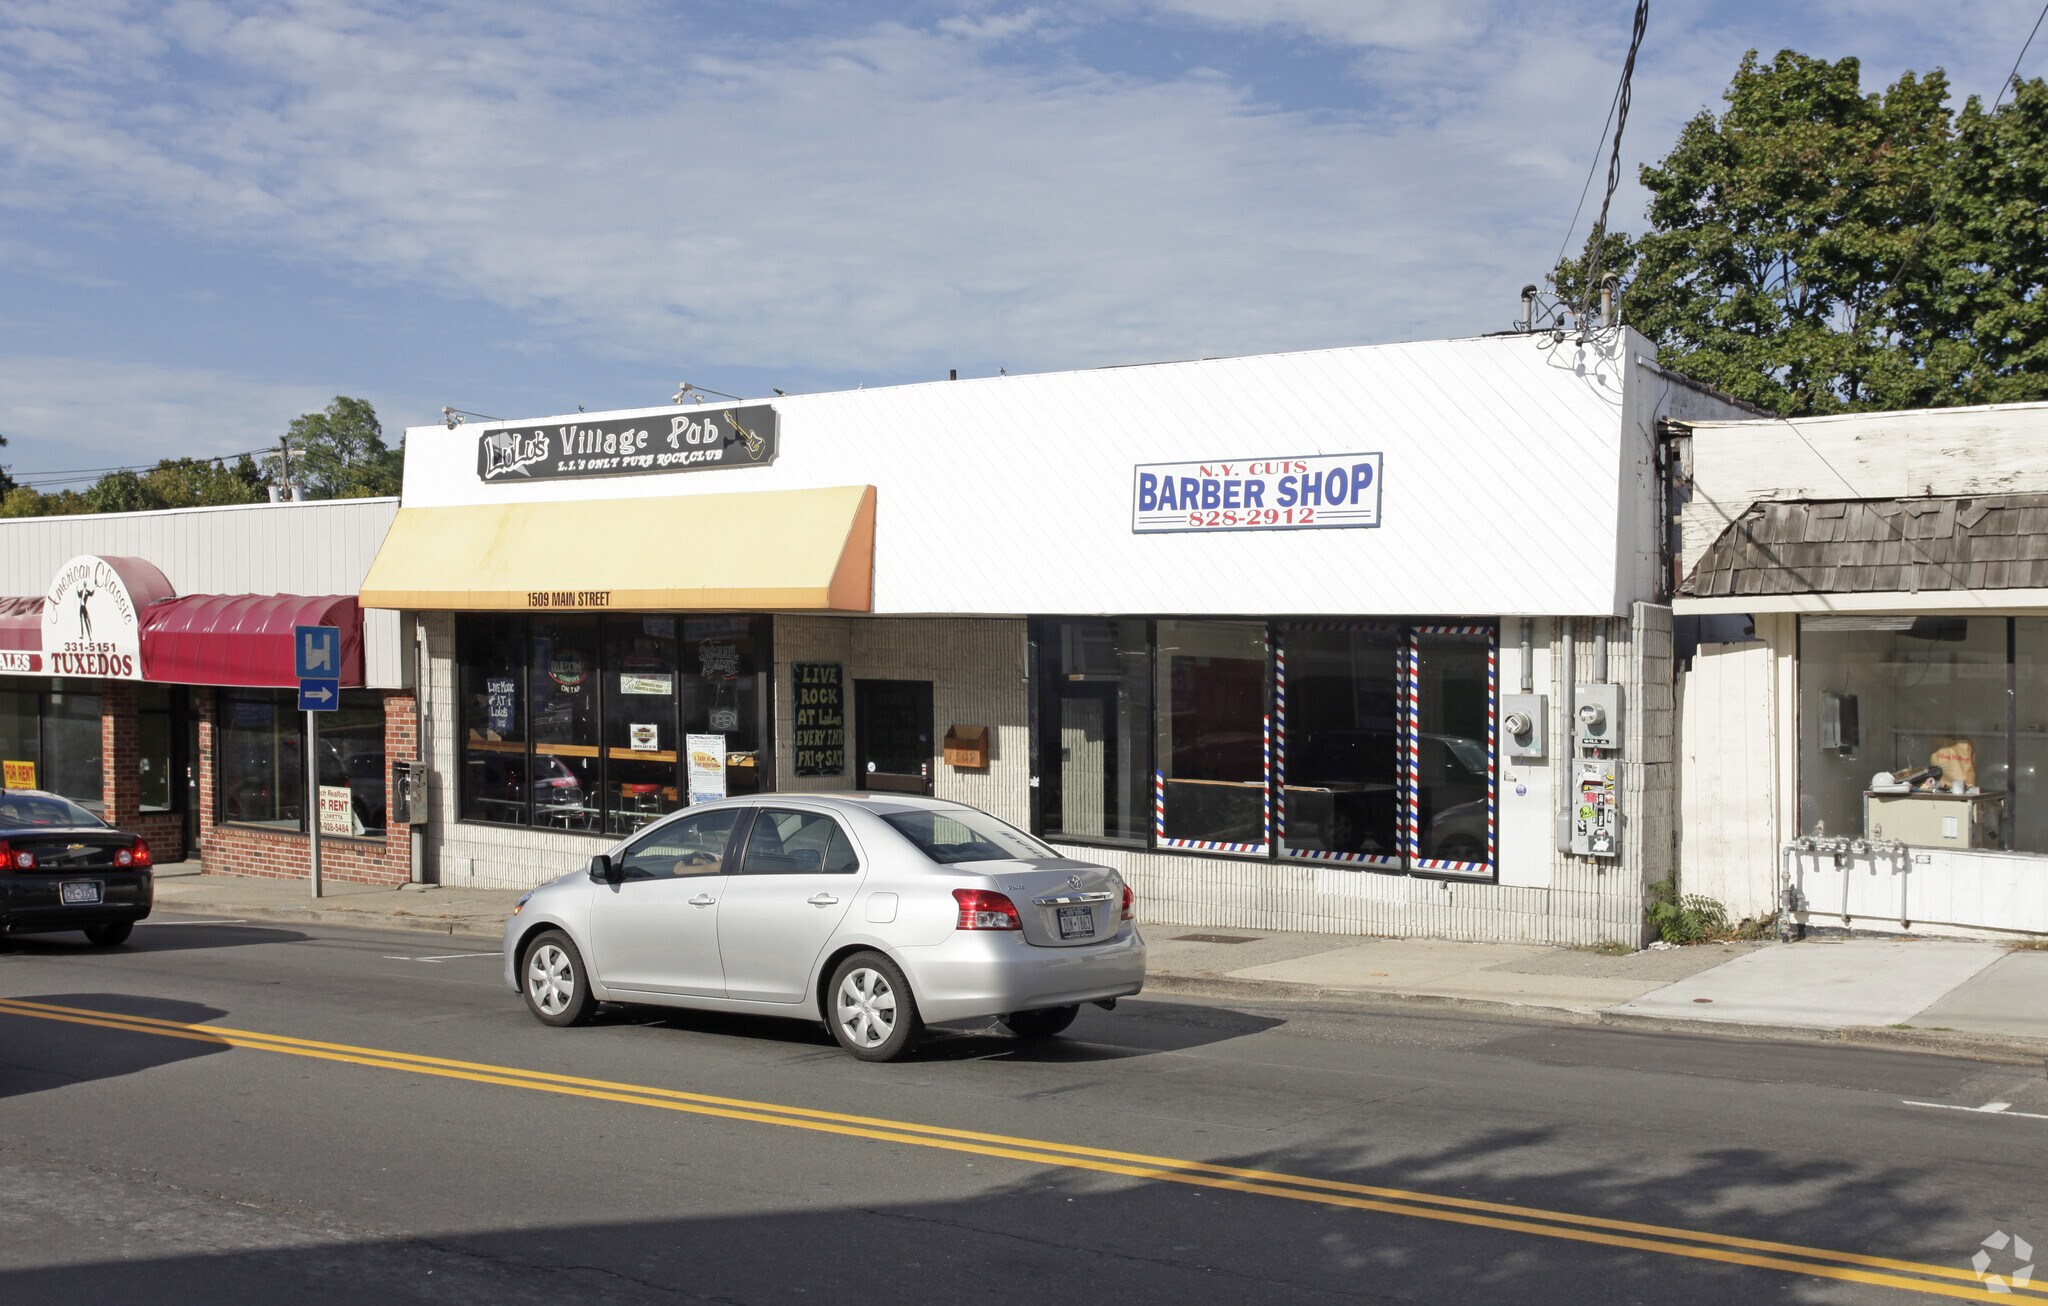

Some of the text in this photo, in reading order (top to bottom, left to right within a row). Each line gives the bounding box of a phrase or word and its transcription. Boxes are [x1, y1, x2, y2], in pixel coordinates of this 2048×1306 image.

[559, 426, 648, 455] Village
[666, 416, 719, 449] Pub
[587, 457, 621, 470] ONLY
[622, 454, 654, 468] PURE
[656, 451, 690, 467] ROCK
[689, 449, 723, 462] CLUB
[1199, 460, 1308, 477] N.Y. CUTS
[1138, 462, 1373, 511] BARBER SHOP
[1188, 507, 1315, 527] 828-2912
[48, 561, 132, 625] American Classic
[527, 591, 611, 607] 1509 MAIN STREET
[64, 642, 117, 653] 331-5151
[0, 653, 30, 671] ALES
[51, 652, 133, 677] TUXEDOS
[802, 667, 838, 684] LIVE
[801, 688, 838, 704] ROCK
[710, 714, 737, 727] OPEN
[797, 709, 816, 726] AT
[796, 729, 826, 746] EVERY
[797, 750, 815, 767] FRI
[825, 750, 844, 767] SAT
[5, 764, 34, 782] FOR RENT
[328, 799, 349, 812] RENT
